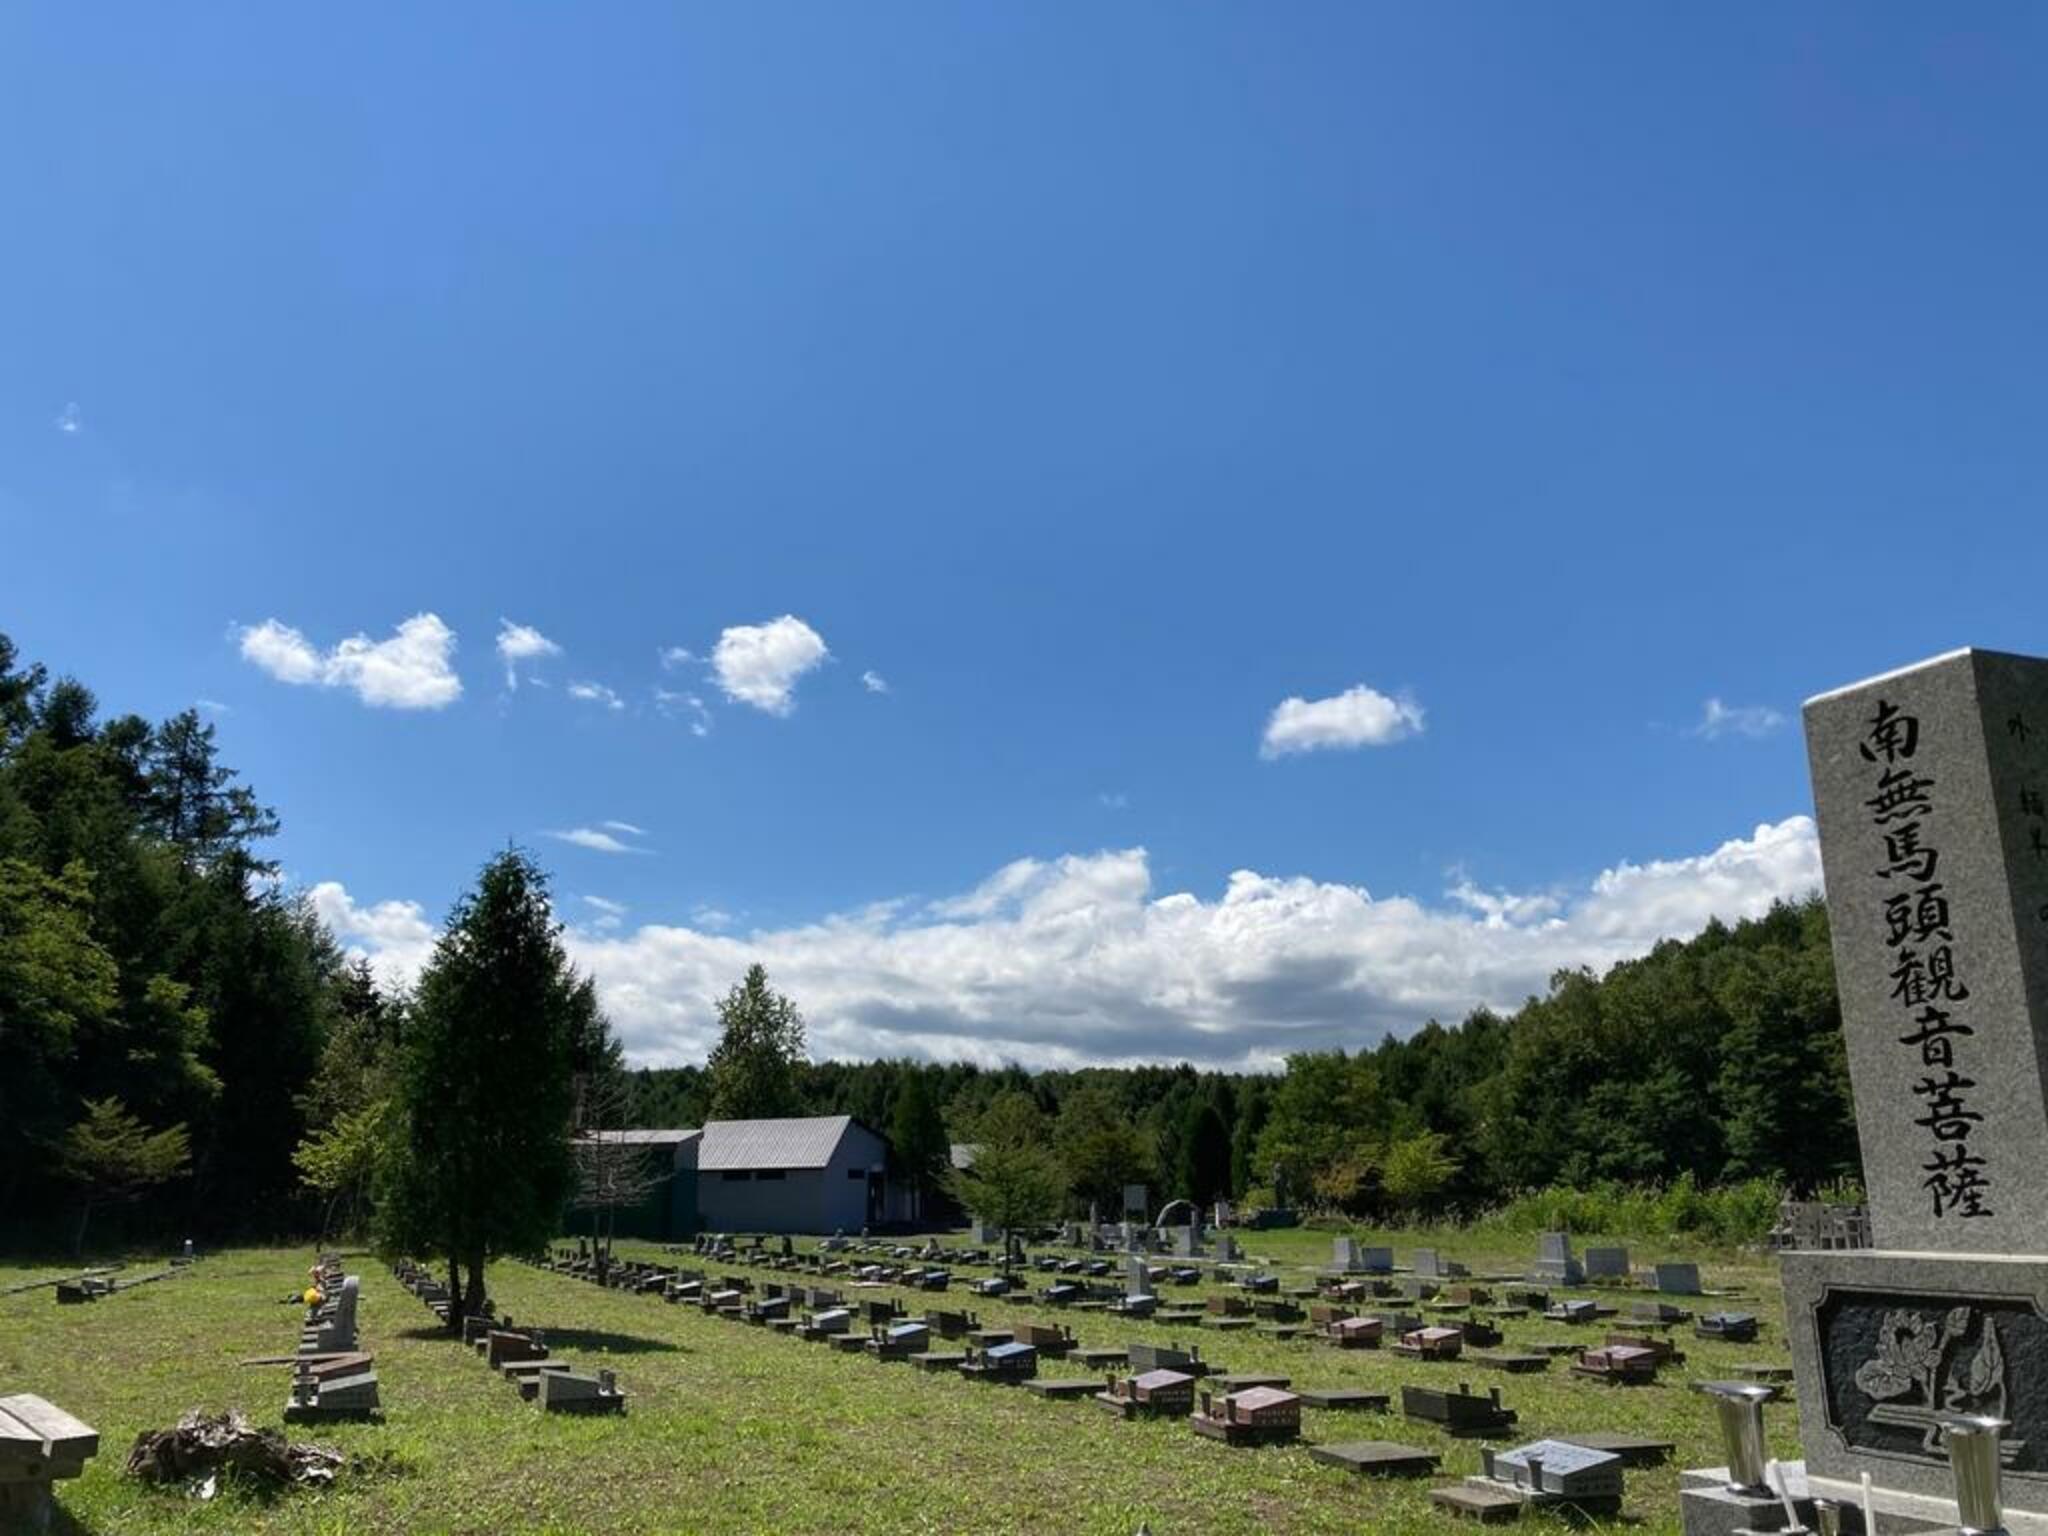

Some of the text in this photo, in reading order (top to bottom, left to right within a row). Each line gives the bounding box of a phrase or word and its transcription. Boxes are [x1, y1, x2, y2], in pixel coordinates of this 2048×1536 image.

[1859, 699, 1993, 1218] 南無馬頭観音菩薩
